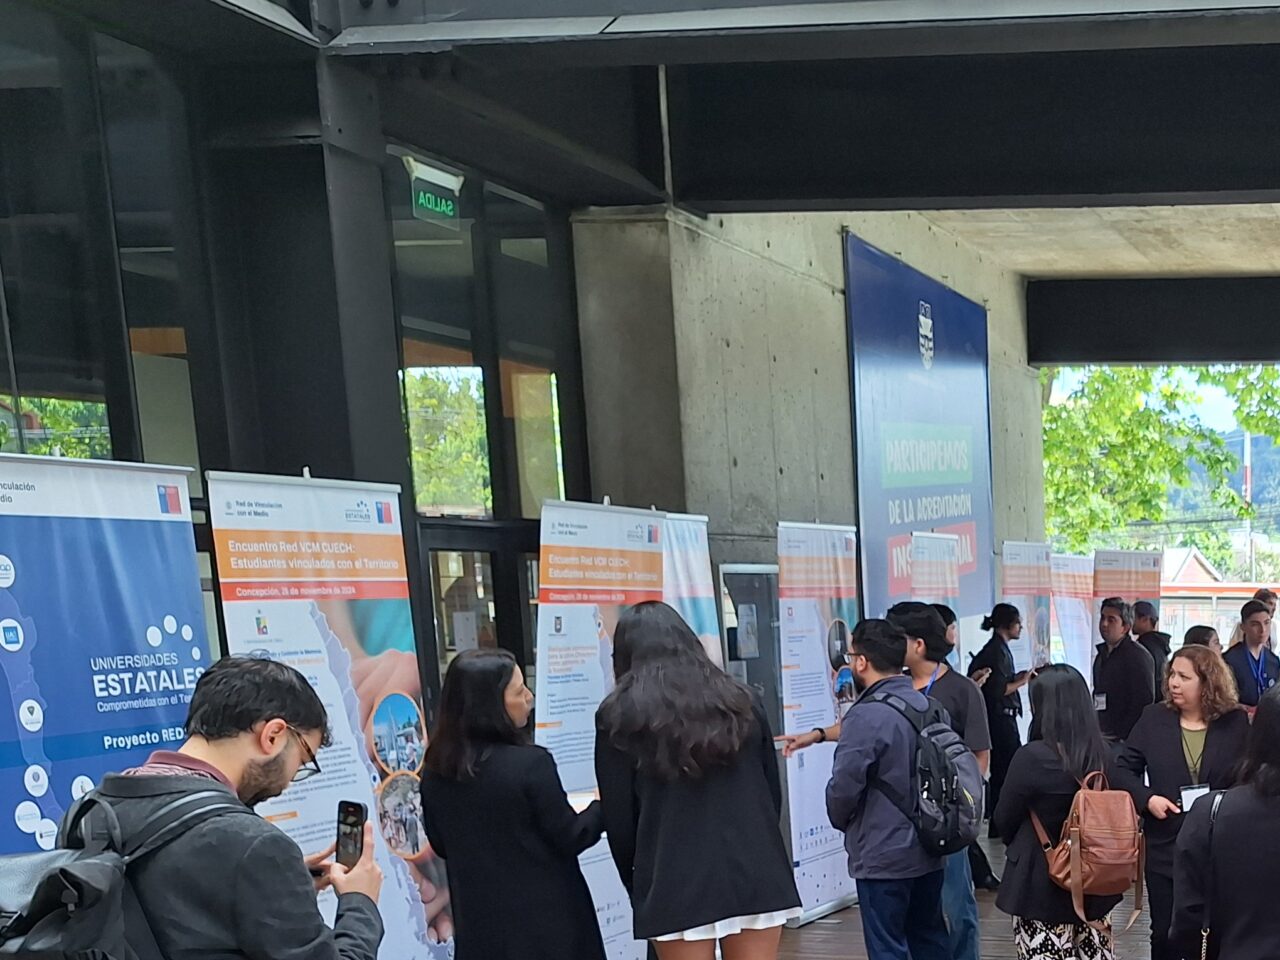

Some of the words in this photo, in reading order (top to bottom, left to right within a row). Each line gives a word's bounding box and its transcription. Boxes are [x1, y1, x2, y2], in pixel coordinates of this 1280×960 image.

[888, 499, 901, 525] DE
[902, 498, 915, 523] LA
[228, 540, 278, 552] Encuentro
[280, 541, 297, 552] Red
[299, 542, 320, 553] VCM
[230, 557, 286, 569] Estudiantes
[288, 557, 335, 569] vinculados
[337, 560, 353, 569] con
[354, 558, 362, 569] el
[90, 652, 178, 670] UNIVERSIDADES
[97, 697, 156, 712] Comprometidas
[157, 698, 169, 706] con
[170, 695, 178, 705] el
[103, 731, 159, 749] Proyecto
[162, 727, 187, 741] RED
